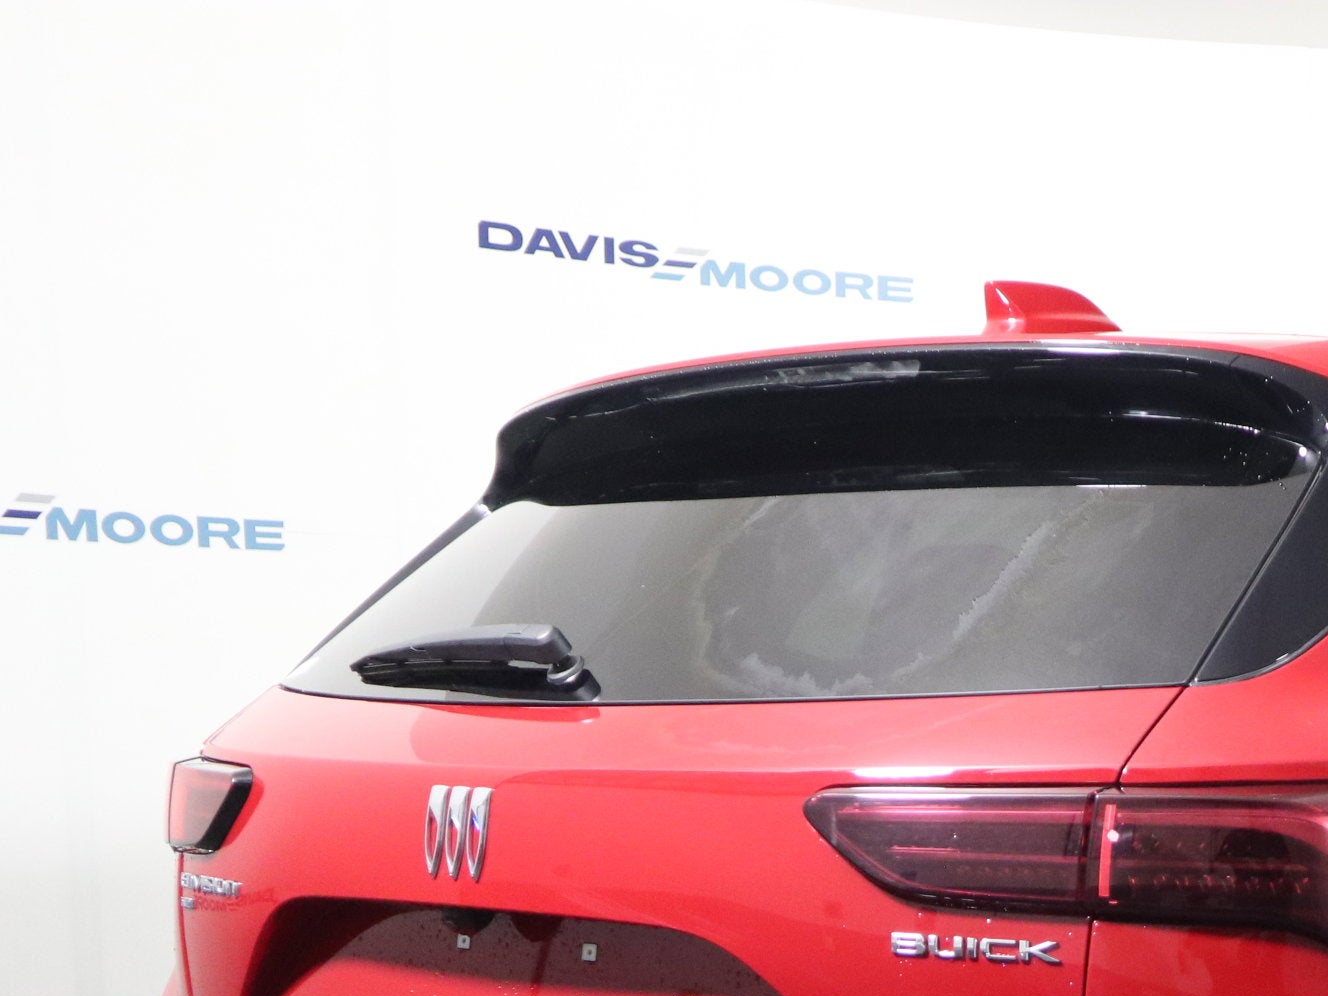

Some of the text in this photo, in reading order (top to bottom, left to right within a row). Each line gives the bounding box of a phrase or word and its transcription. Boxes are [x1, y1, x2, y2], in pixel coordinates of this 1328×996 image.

[478, 219, 915, 303] DAVIS MOORE
[45, 507, 286, 552] MOORE
[890, 931, 1063, 965] BUICK
